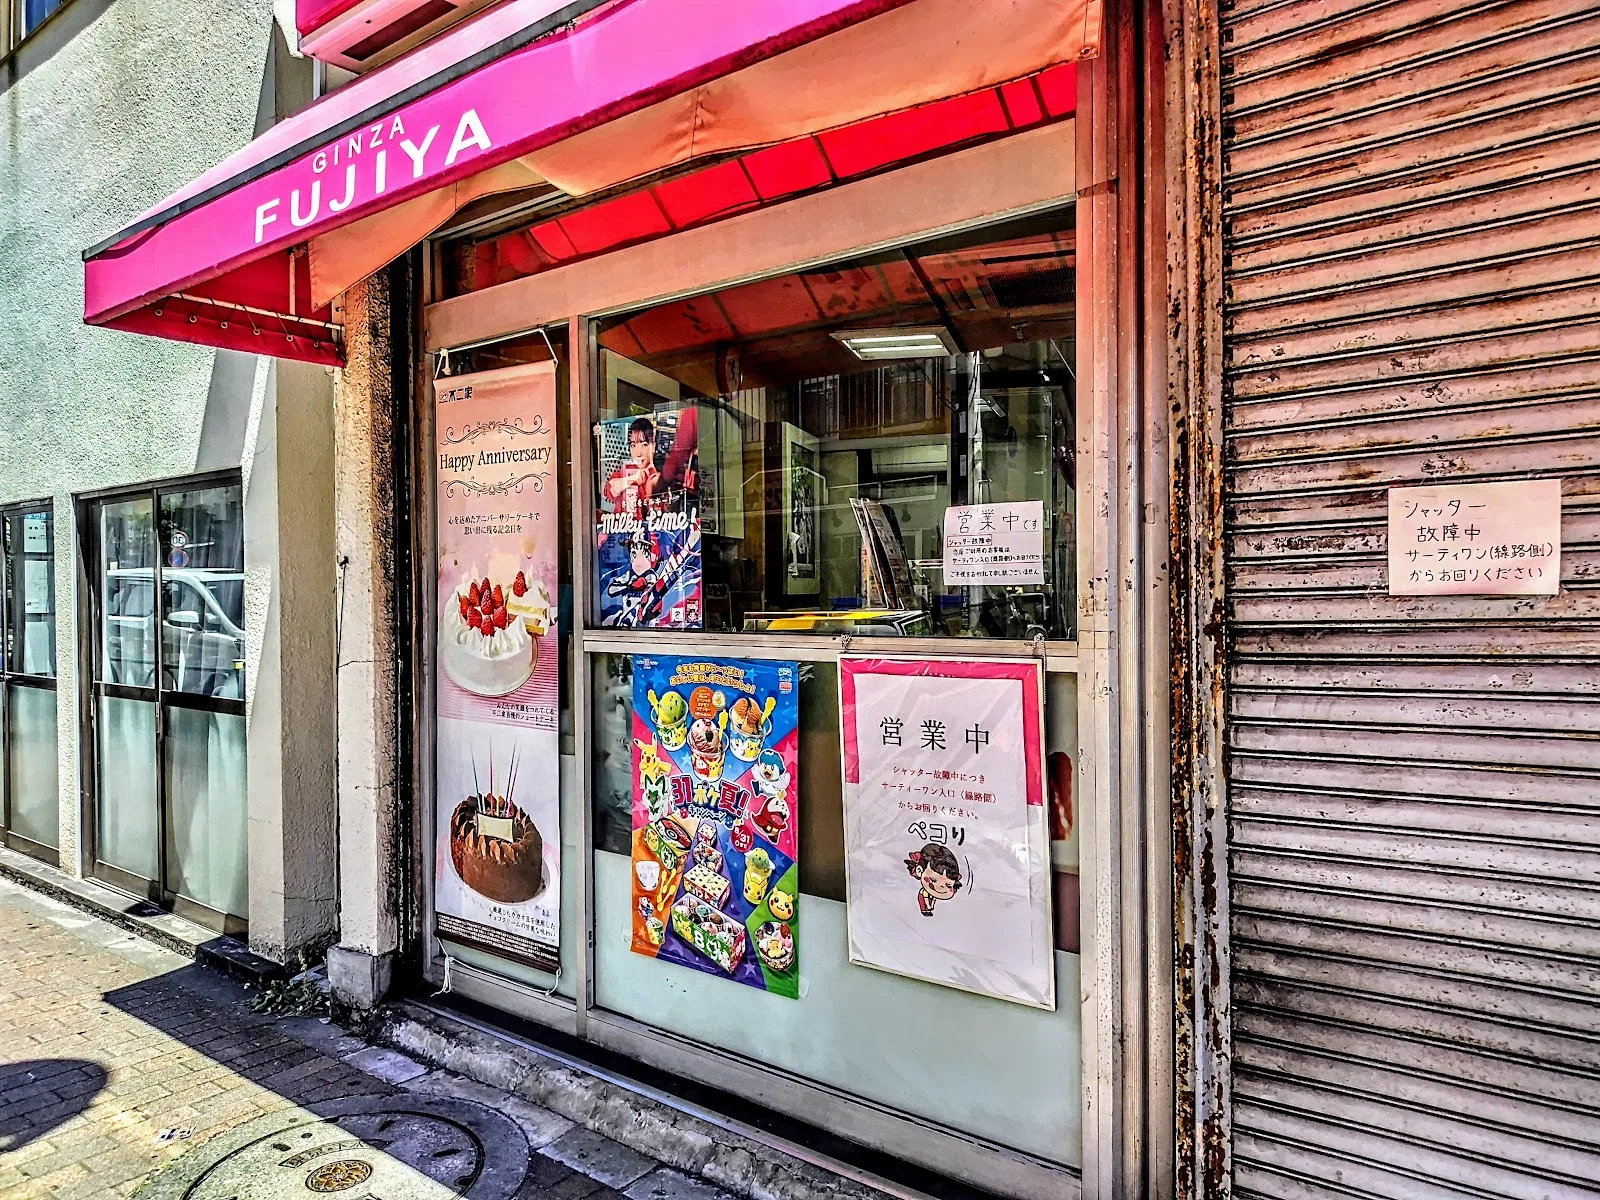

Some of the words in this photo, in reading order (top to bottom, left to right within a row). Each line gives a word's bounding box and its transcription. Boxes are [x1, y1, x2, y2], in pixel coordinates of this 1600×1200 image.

[312, 115, 405, 174] GINZA
[254, 108, 492, 244] FUJIYA
[448, 386, 473, 402] 不二家
[439, 453, 475, 473] Happy
[477, 446, 552, 466] Anniversary
[1404, 499, 1487, 519] シャッター
[600, 512, 645, 543] Milky
[957, 508, 1038, 534] 営業中です
[1416, 522, 1482, 543] 故障中
[1405, 543, 1554, 563] サーティワン(線路側)
[1409, 567, 1543, 583] からお回りください
[879, 716, 990, 755] 営業中
[892, 766, 986, 784] シャッター故障中につき
[898, 801, 979, 820] からお回りください。
[907, 821, 965, 846] ペコり
